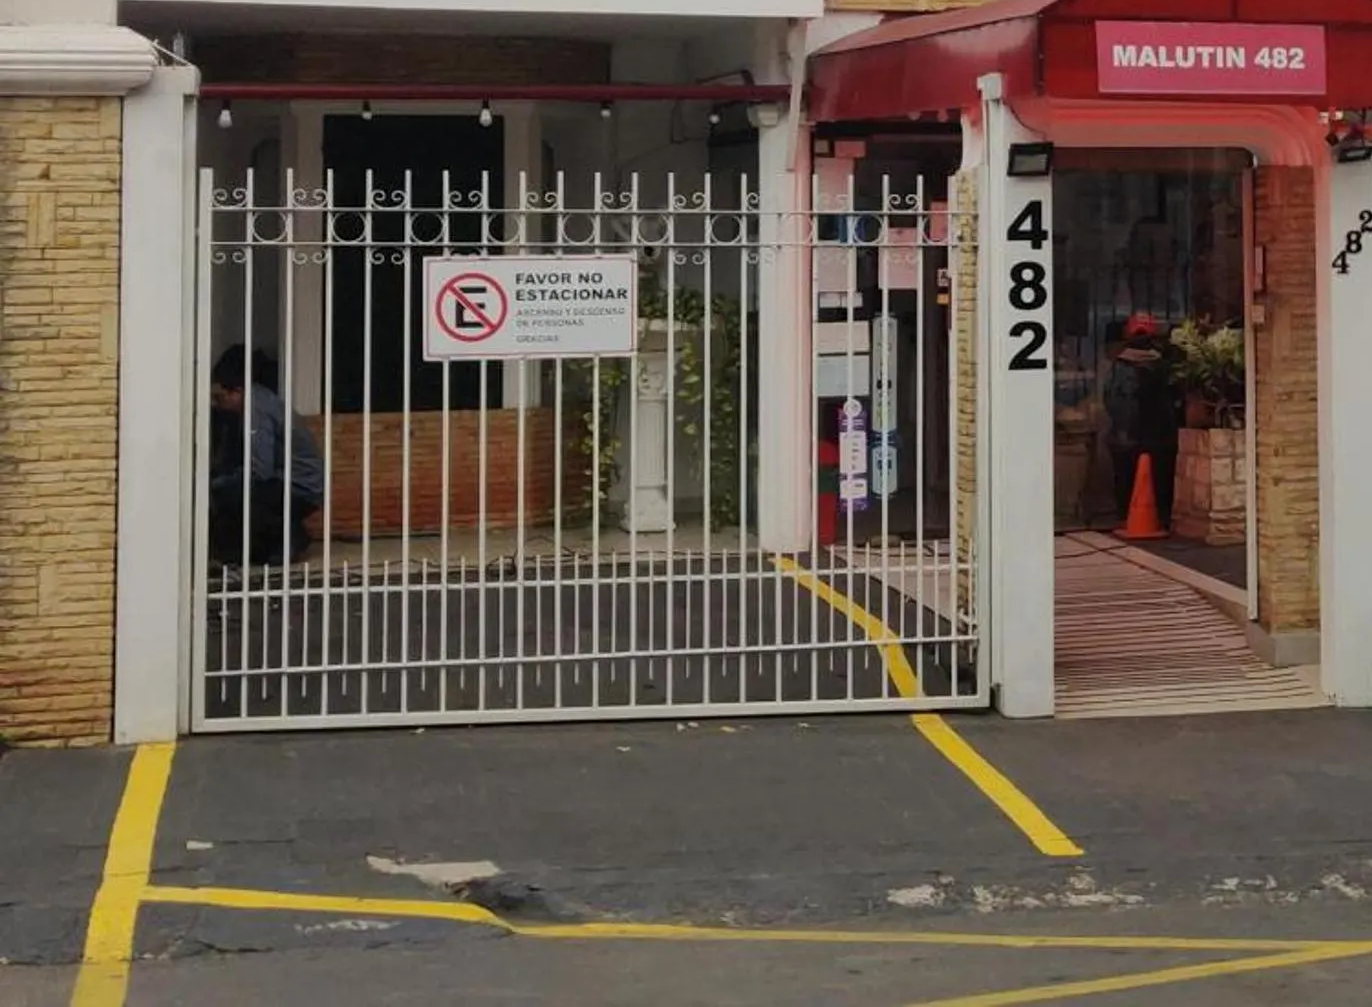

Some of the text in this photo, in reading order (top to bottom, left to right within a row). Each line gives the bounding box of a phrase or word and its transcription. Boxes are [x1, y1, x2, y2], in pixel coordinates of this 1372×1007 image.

[1112, 45, 1306, 70] MALUTIN 482
[515, 273, 603, 285] FAVOR NO
[1006, 200, 1049, 371] 482
[515, 288, 628, 301] ESTACIONAR
